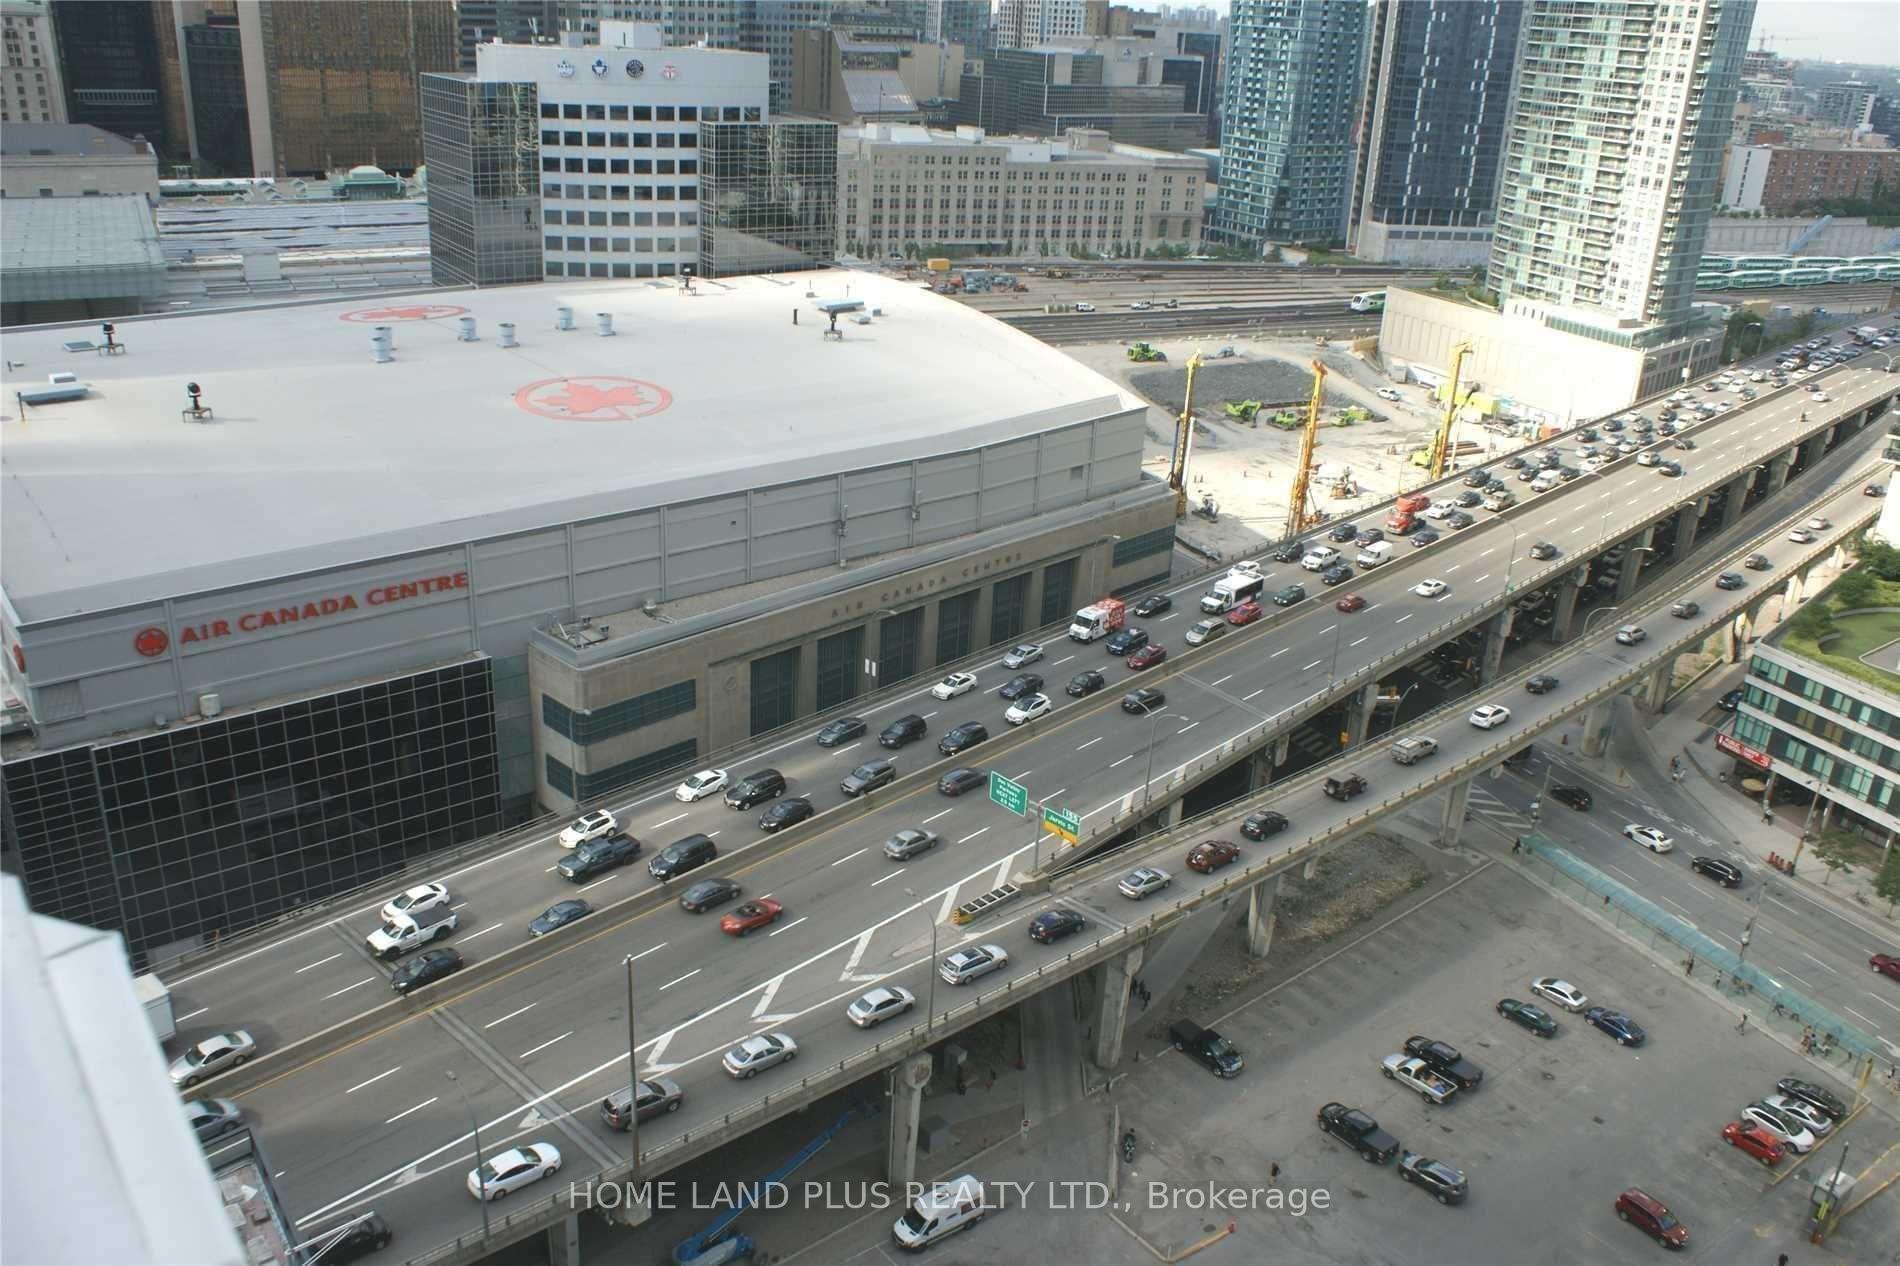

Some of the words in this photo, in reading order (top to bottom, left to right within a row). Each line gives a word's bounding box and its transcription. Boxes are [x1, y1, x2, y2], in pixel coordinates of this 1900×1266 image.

[238, 594, 359, 632] CANADA
[366, 572, 469, 606] CENTRE
[831, 601, 864, 618] AIR
[881, 576, 947, 602] CANADA
[961, 552, 1022, 577] CENTRE
[1049, 815, 1066, 828] Jarvis
